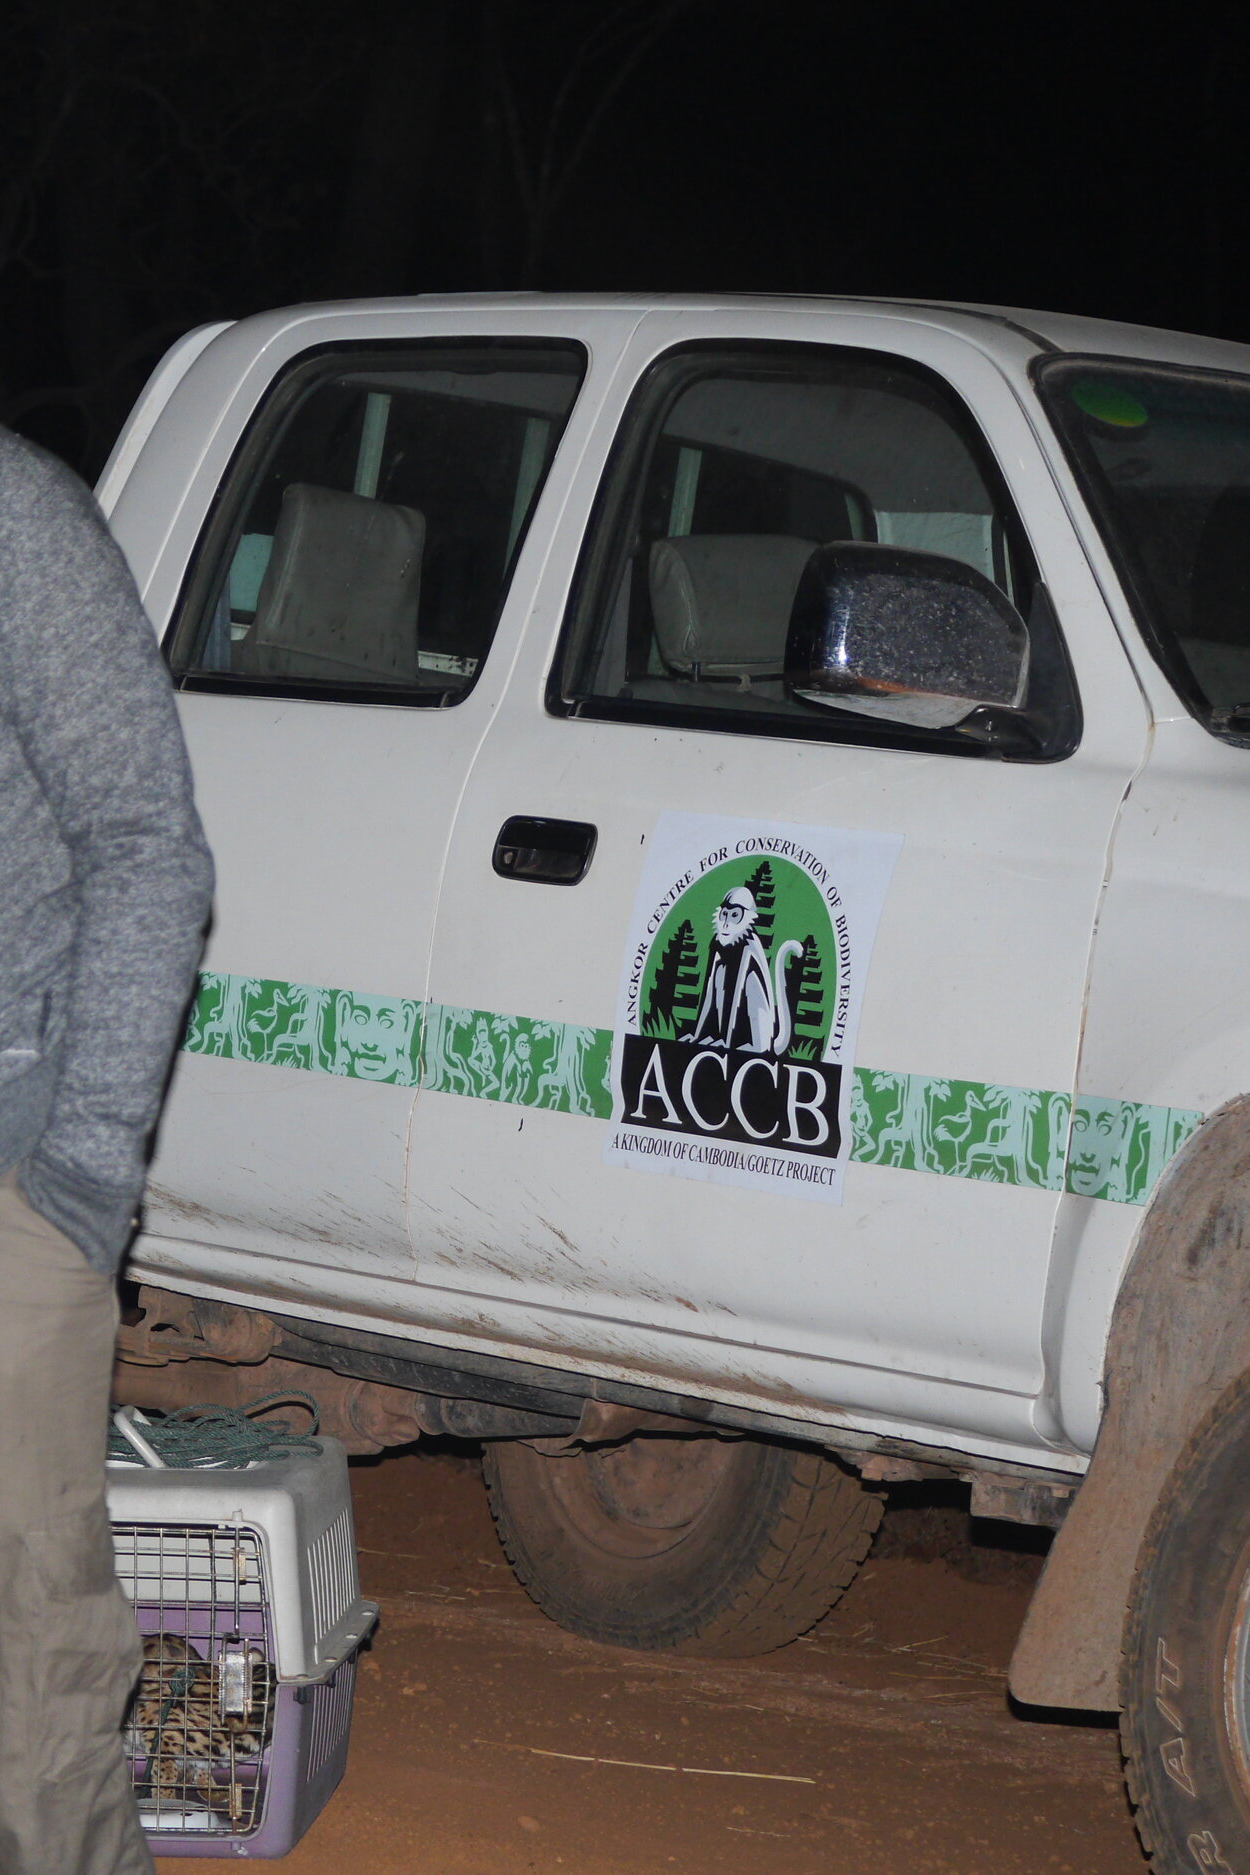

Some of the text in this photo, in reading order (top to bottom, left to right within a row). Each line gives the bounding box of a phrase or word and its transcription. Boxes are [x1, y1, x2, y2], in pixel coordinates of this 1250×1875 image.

[626, 837, 851, 1058] ANGKOR CENTRE FOR CONSERVATION OF BIODIVERSITY
[611, 1132, 837, 1187] A KINGDOM OF CAMBODIA/GOETZ PROJECT
[630, 1042, 830, 1147] ACCB
[1155, 1636, 1197, 1798] A/T
